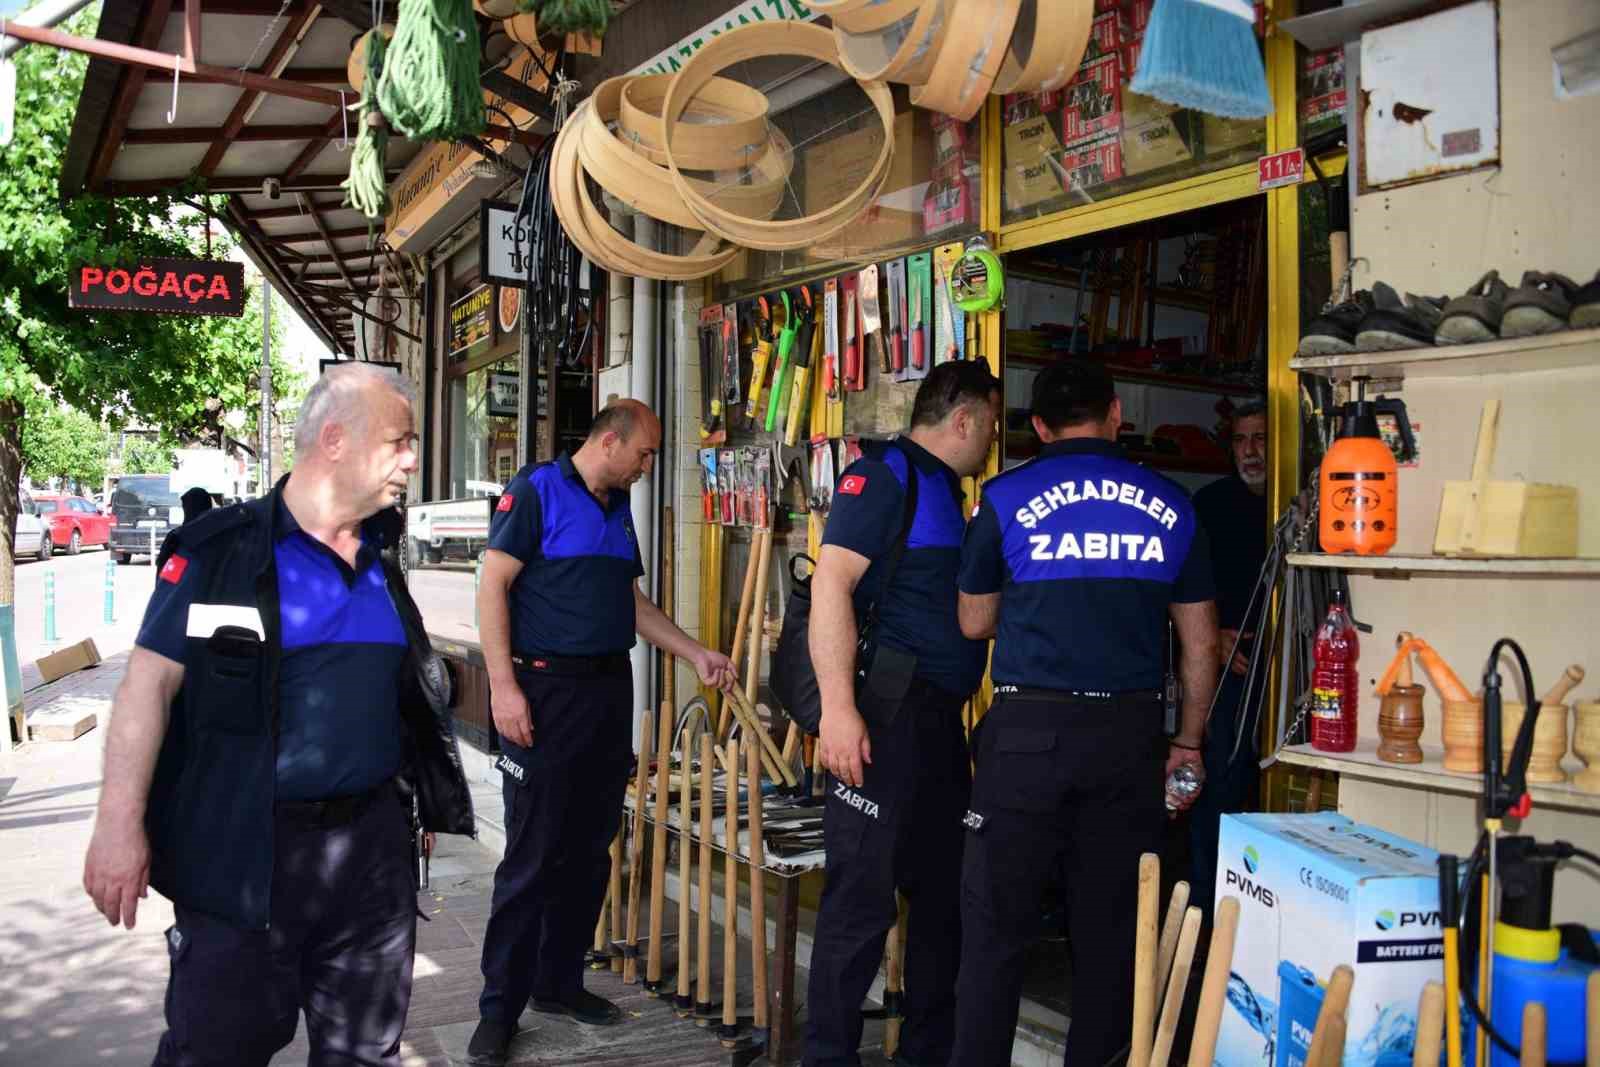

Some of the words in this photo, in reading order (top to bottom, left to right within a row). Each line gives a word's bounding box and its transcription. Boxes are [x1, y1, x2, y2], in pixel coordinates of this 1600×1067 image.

[80, 265, 231, 304] POĞAÇA
[1016, 479, 1178, 530] ŞEHZADELER
[1028, 532, 1165, 562] ZABITA
[499, 755, 525, 781] ZABITA
[834, 782, 881, 819] ZABITA
[1226, 869, 1274, 908] PVMS
[1375, 944, 1427, 959] BATTERY
